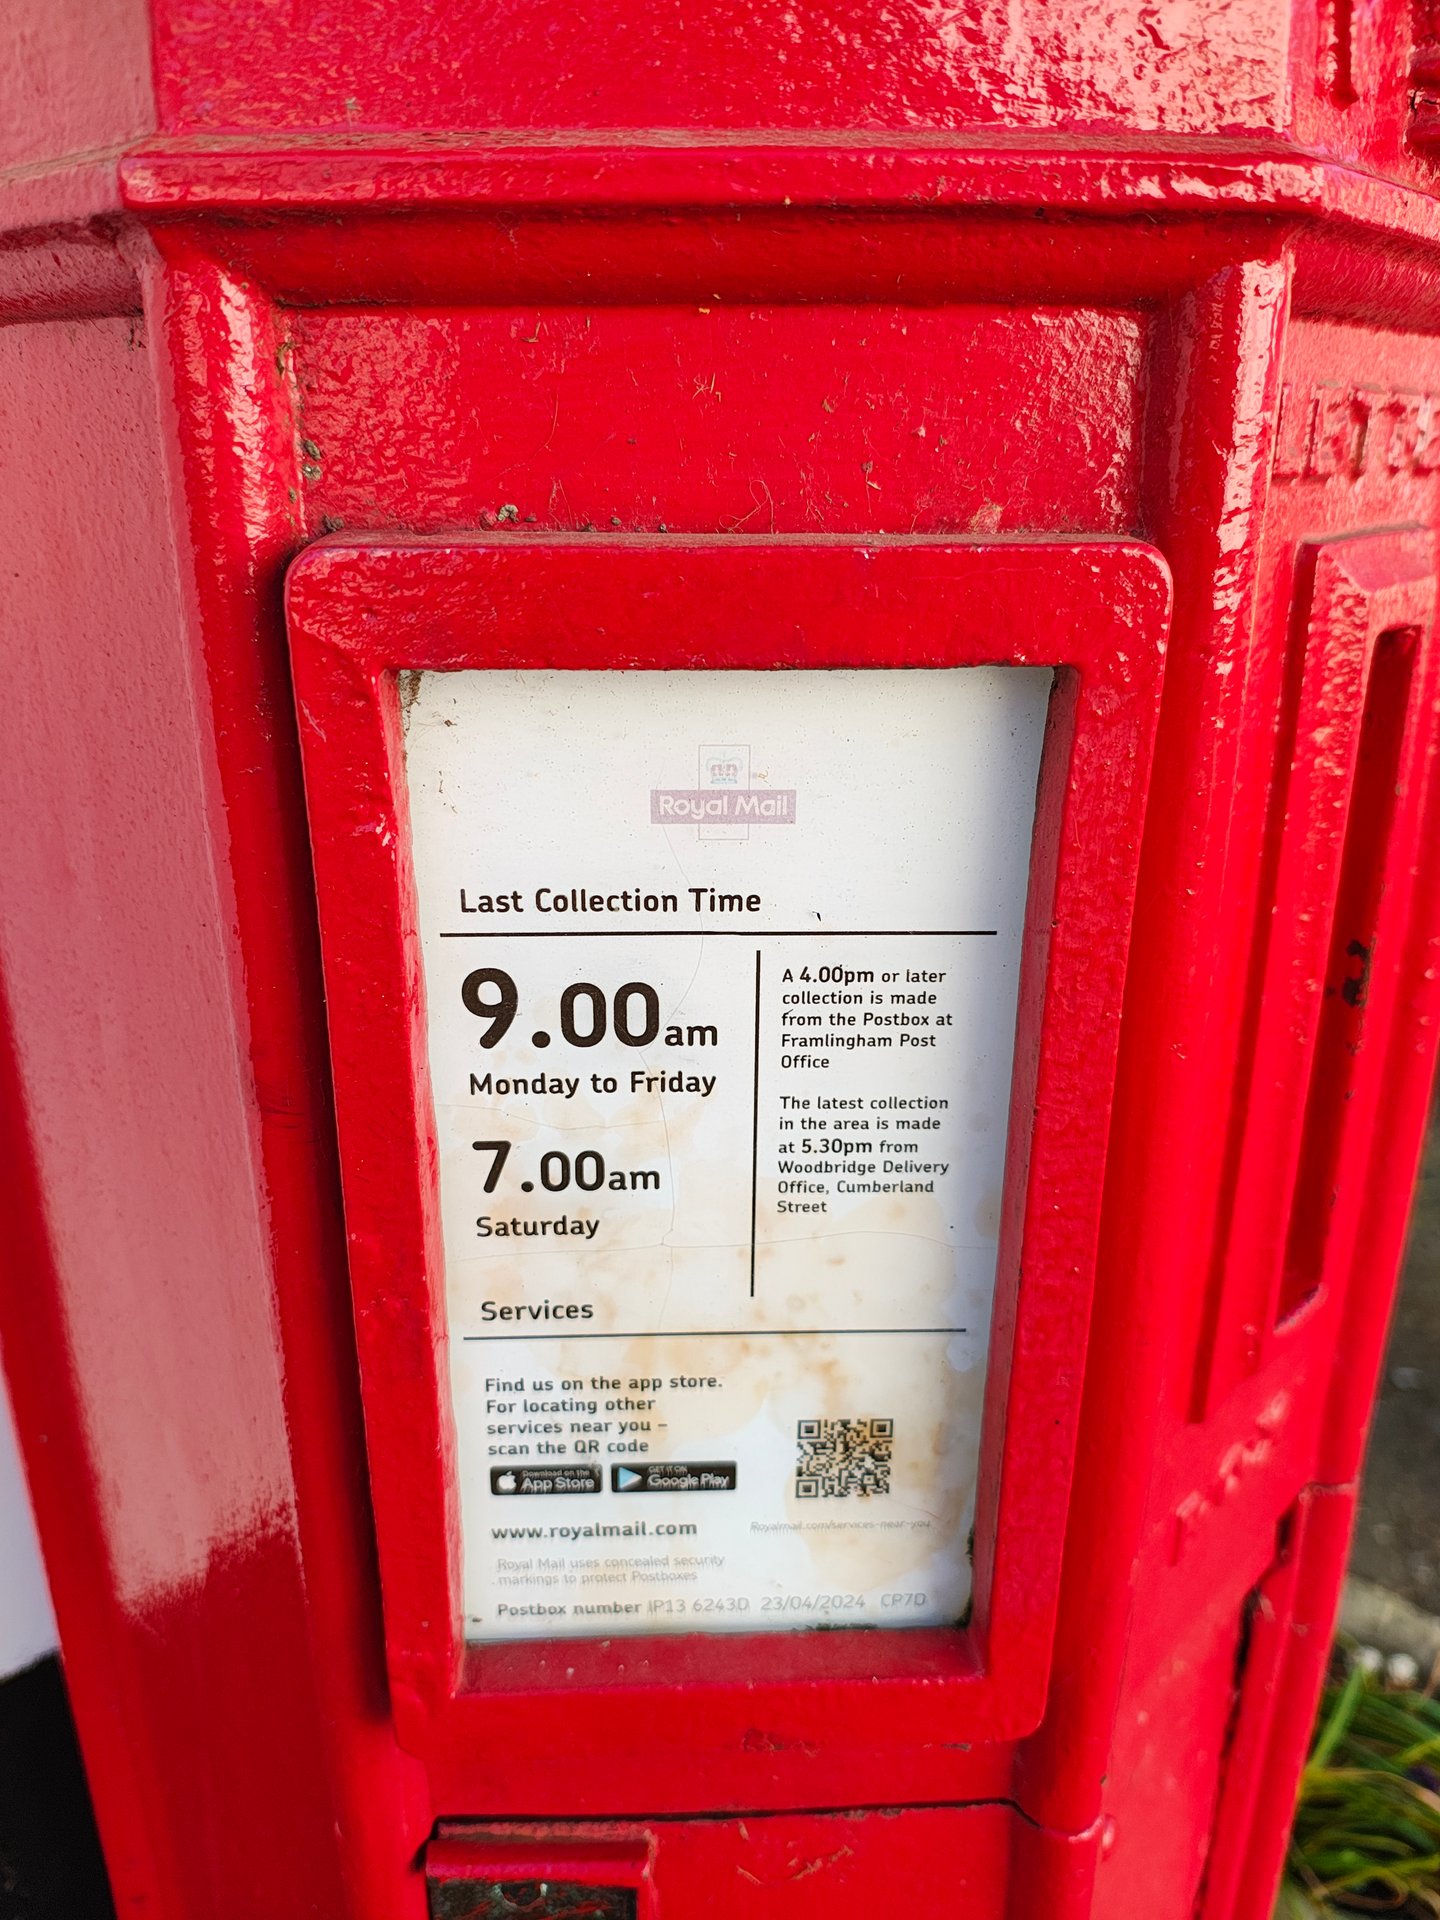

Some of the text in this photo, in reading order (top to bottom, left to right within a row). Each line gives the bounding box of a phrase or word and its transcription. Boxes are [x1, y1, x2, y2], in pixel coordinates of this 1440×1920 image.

[659, 794, 788, 819] Royal Mail
[460, 888, 761, 913] Last Collection Time
[782, 966, 946, 986] A 4.00pm or later
[783, 990, 937, 1004] collection is made
[462, 968, 717, 1049] 9.00am
[781, 1010, 952, 1026] from the Postbox at
[782, 1033, 936, 1050] Framlingham Post
[781, 1055, 829, 1068] Office
[470, 1070, 716, 1099] Monday to Friday
[779, 1096, 948, 1109] The latest collection
[780, 1116, 940, 1130] in the area is made
[779, 1138, 918, 1157] at 5.30pm from
[472, 1140, 660, 1193] 7.00am
[778, 1160, 949, 1176] Woodbridge Delivery
[778, 1180, 934, 1195] Office, Cumberland
[777, 1200, 827, 1213] Street
[476, 1215, 600, 1239] Saturday
[481, 1299, 593, 1321] Services
[486, 1375, 722, 1392] Find us on the app store.
[487, 1397, 656, 1415] For locating other
[487, 1420, 562, 1435] services
[570, 1422, 612, 1433] near
[618, 1421, 651, 1435] you
[488, 1439, 648, 1455] scan the QR code
[522, 1470, 562, 1478] Download
[576, 1469, 590, 1477] the
[649, 1465, 665, 1473] GET
[674, 1465, 688, 1473] ON
[522, 1476, 595, 1490] App Store
[649, 1472, 730, 1488] Google Play
[492, 1521, 697, 1541] www.royalmail.com
[498, 1554, 727, 1571] Royal Mail uses concealed security
[498, 1570, 699, 1586] markings to protect Postboxes
[497, 1602, 567, 1618] Postbox
[572, 1599, 642, 1615] number
[648, 1599, 687, 1614] IP13
[759, 1594, 867, 1611] 23/04/2024
